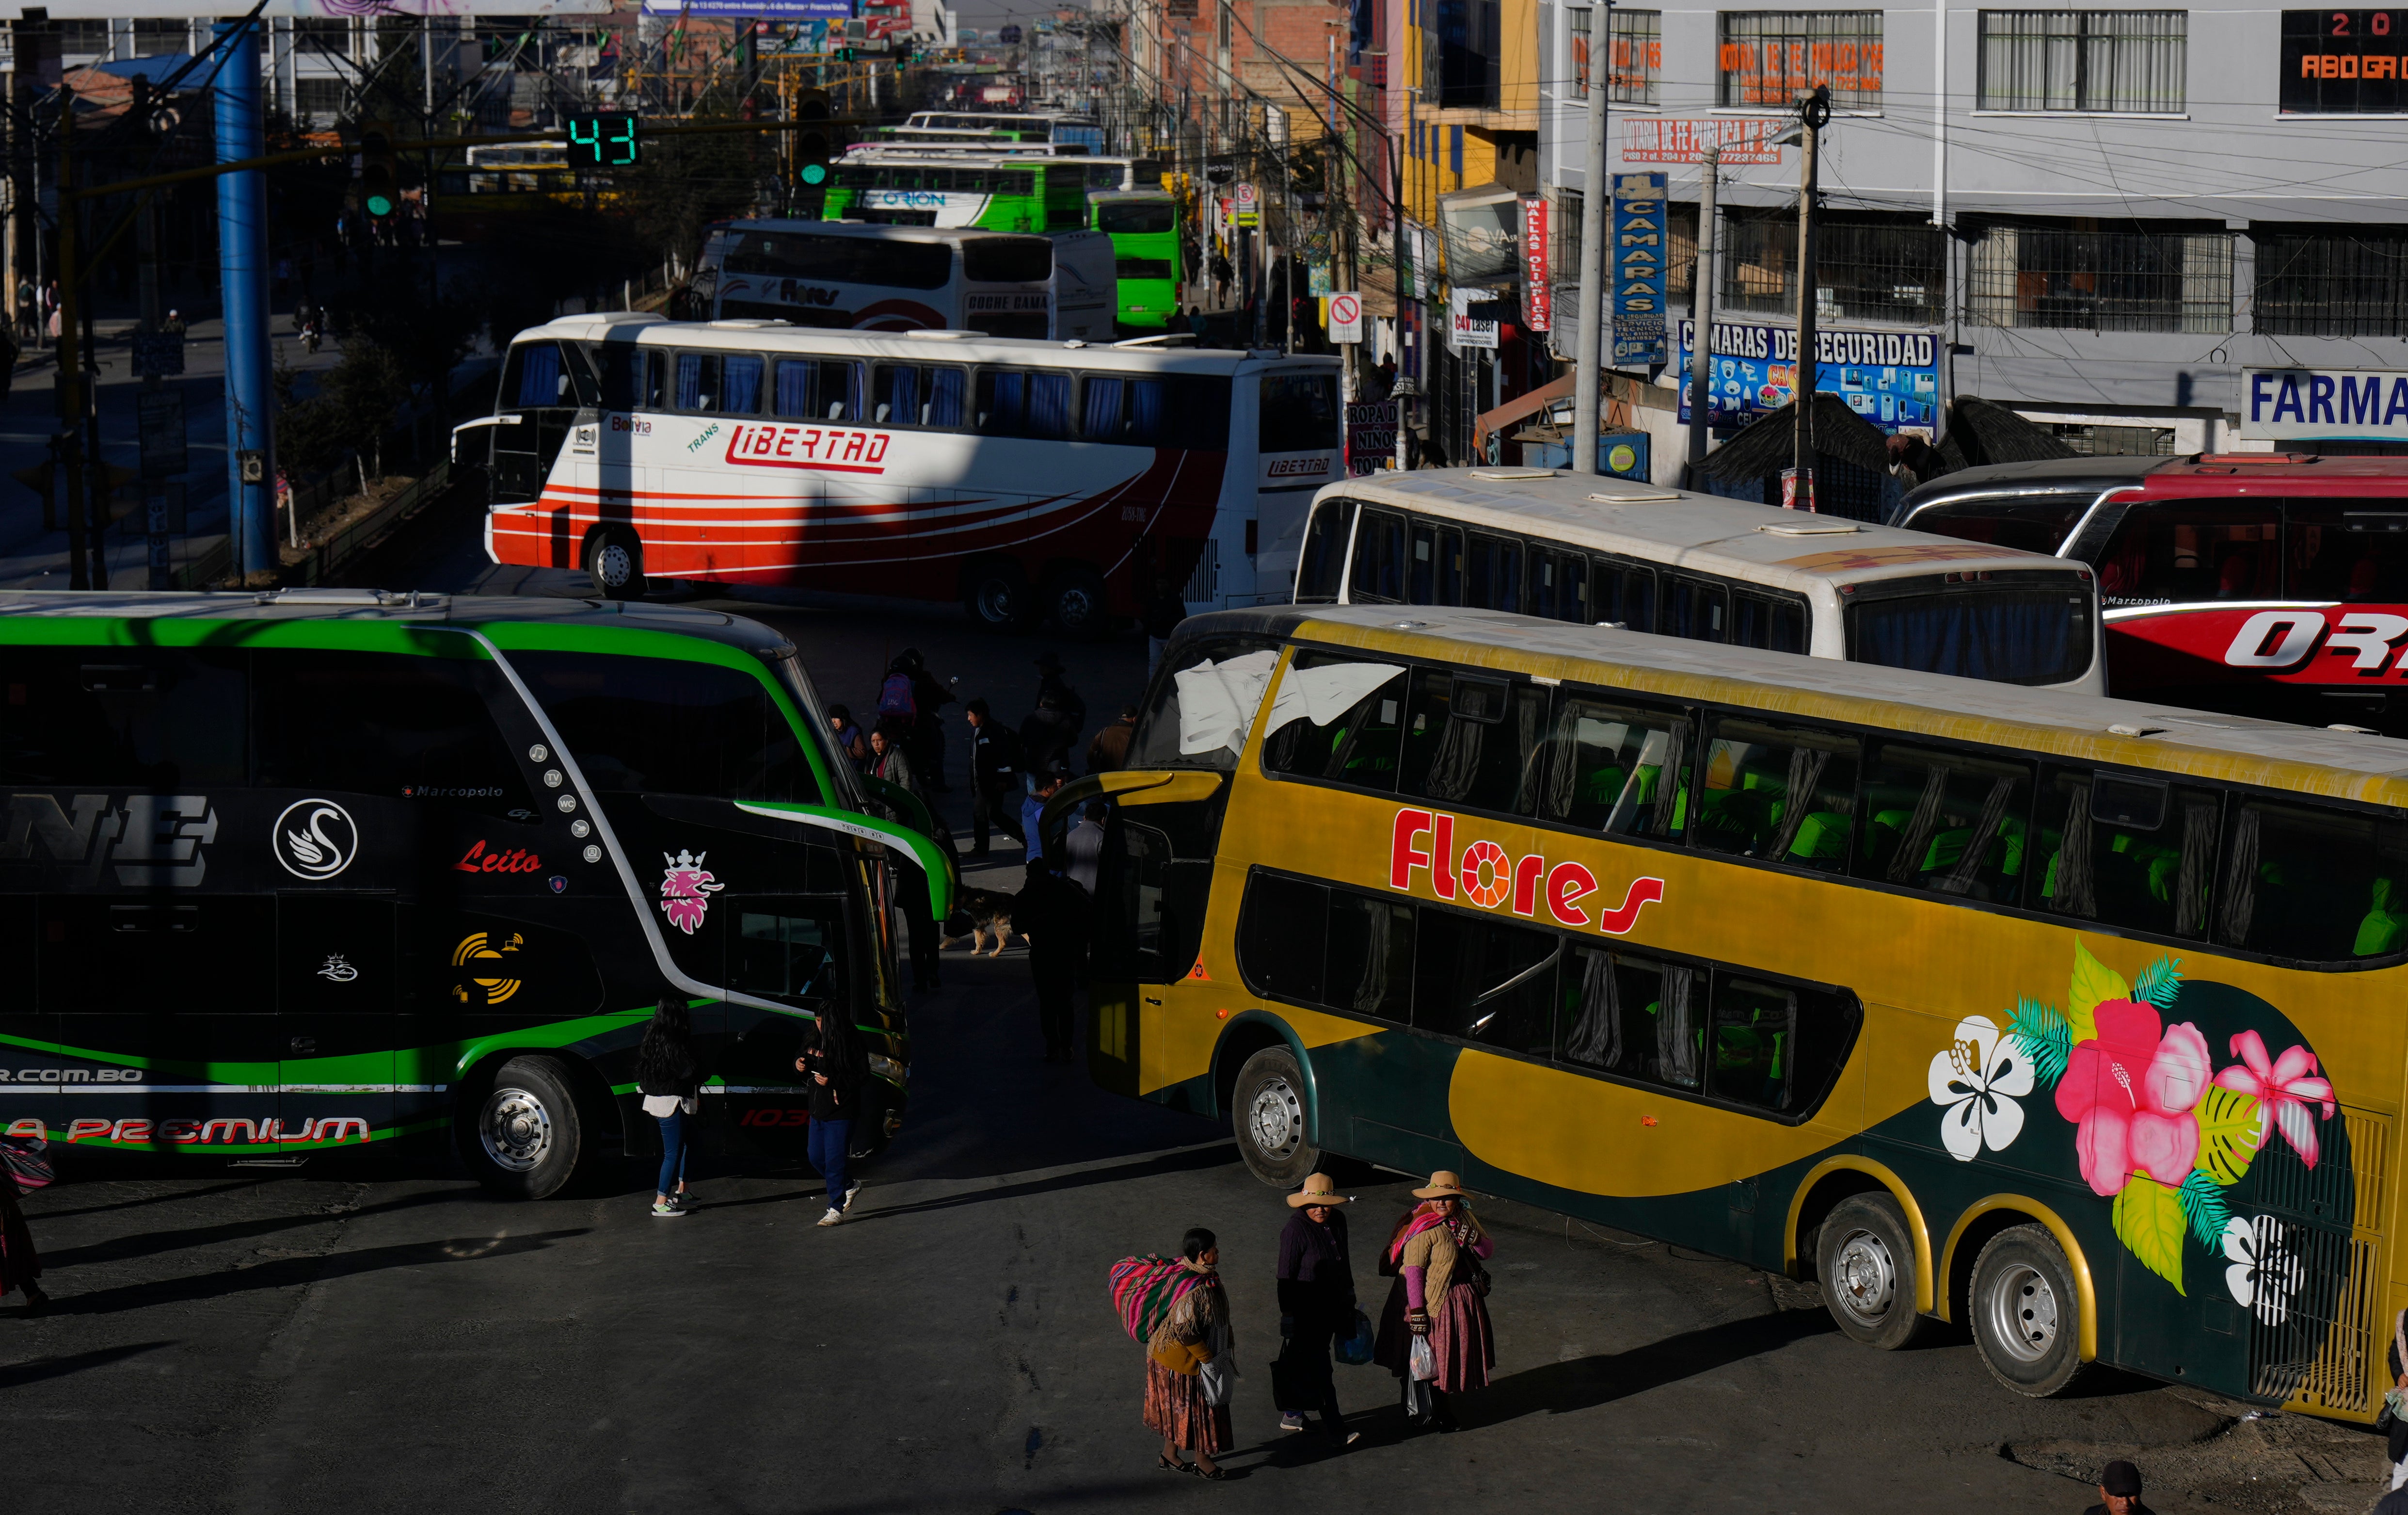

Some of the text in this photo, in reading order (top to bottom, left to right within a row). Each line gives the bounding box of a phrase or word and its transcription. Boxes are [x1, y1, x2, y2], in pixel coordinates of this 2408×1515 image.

[683, 1, 699, 9] Clle
[1649, 43, 1661, 68] 65
[1720, 44, 1754, 71] NOTARIA
[1768, 45, 1778, 71] DE
[1790, 45, 1801, 71] FE
[1871, 44, 1883, 71] 65
[570, 116, 636, 166] 43
[1624, 121, 1659, 151] NOTARIA
[1661, 121, 1674, 151] DE
[1675, 121, 1688, 151] FE
[1691, 121, 1740, 152] PUBLICA
[1762, 122, 1780, 152] 65
[884, 192, 945, 208] ORION
[1526, 200, 1540, 250] MALLAS
[1621, 201, 1658, 311] CAMARAS
[781, 279, 840, 306] Flores
[1529, 256, 1546, 329] OLIMPICAS
[1455, 314, 1494, 333] C4V Laser
[1682, 321, 1769, 360] CMARAS
[1773, 329, 1797, 361] DE
[2251, 374, 2408, 425] FARMA
[612, 415, 651, 433] Bolivia
[1349, 404, 1398, 423] ROPA D
[686, 423, 719, 453] TRANS
[1356, 425, 1398, 450] NIÑOS
[2107, 596, 2171, 606] Marcopolo
[2225, 611, 2408, 669] OR
[546, 773, 559, 782] TV
[416, 785, 504, 798] Marcopolo
[450, 839, 542, 873] Leito
[1389, 807, 1665, 935] Flores
[317, 964, 358, 982] 25
[66, 1117, 371, 1144] PREMIUM
